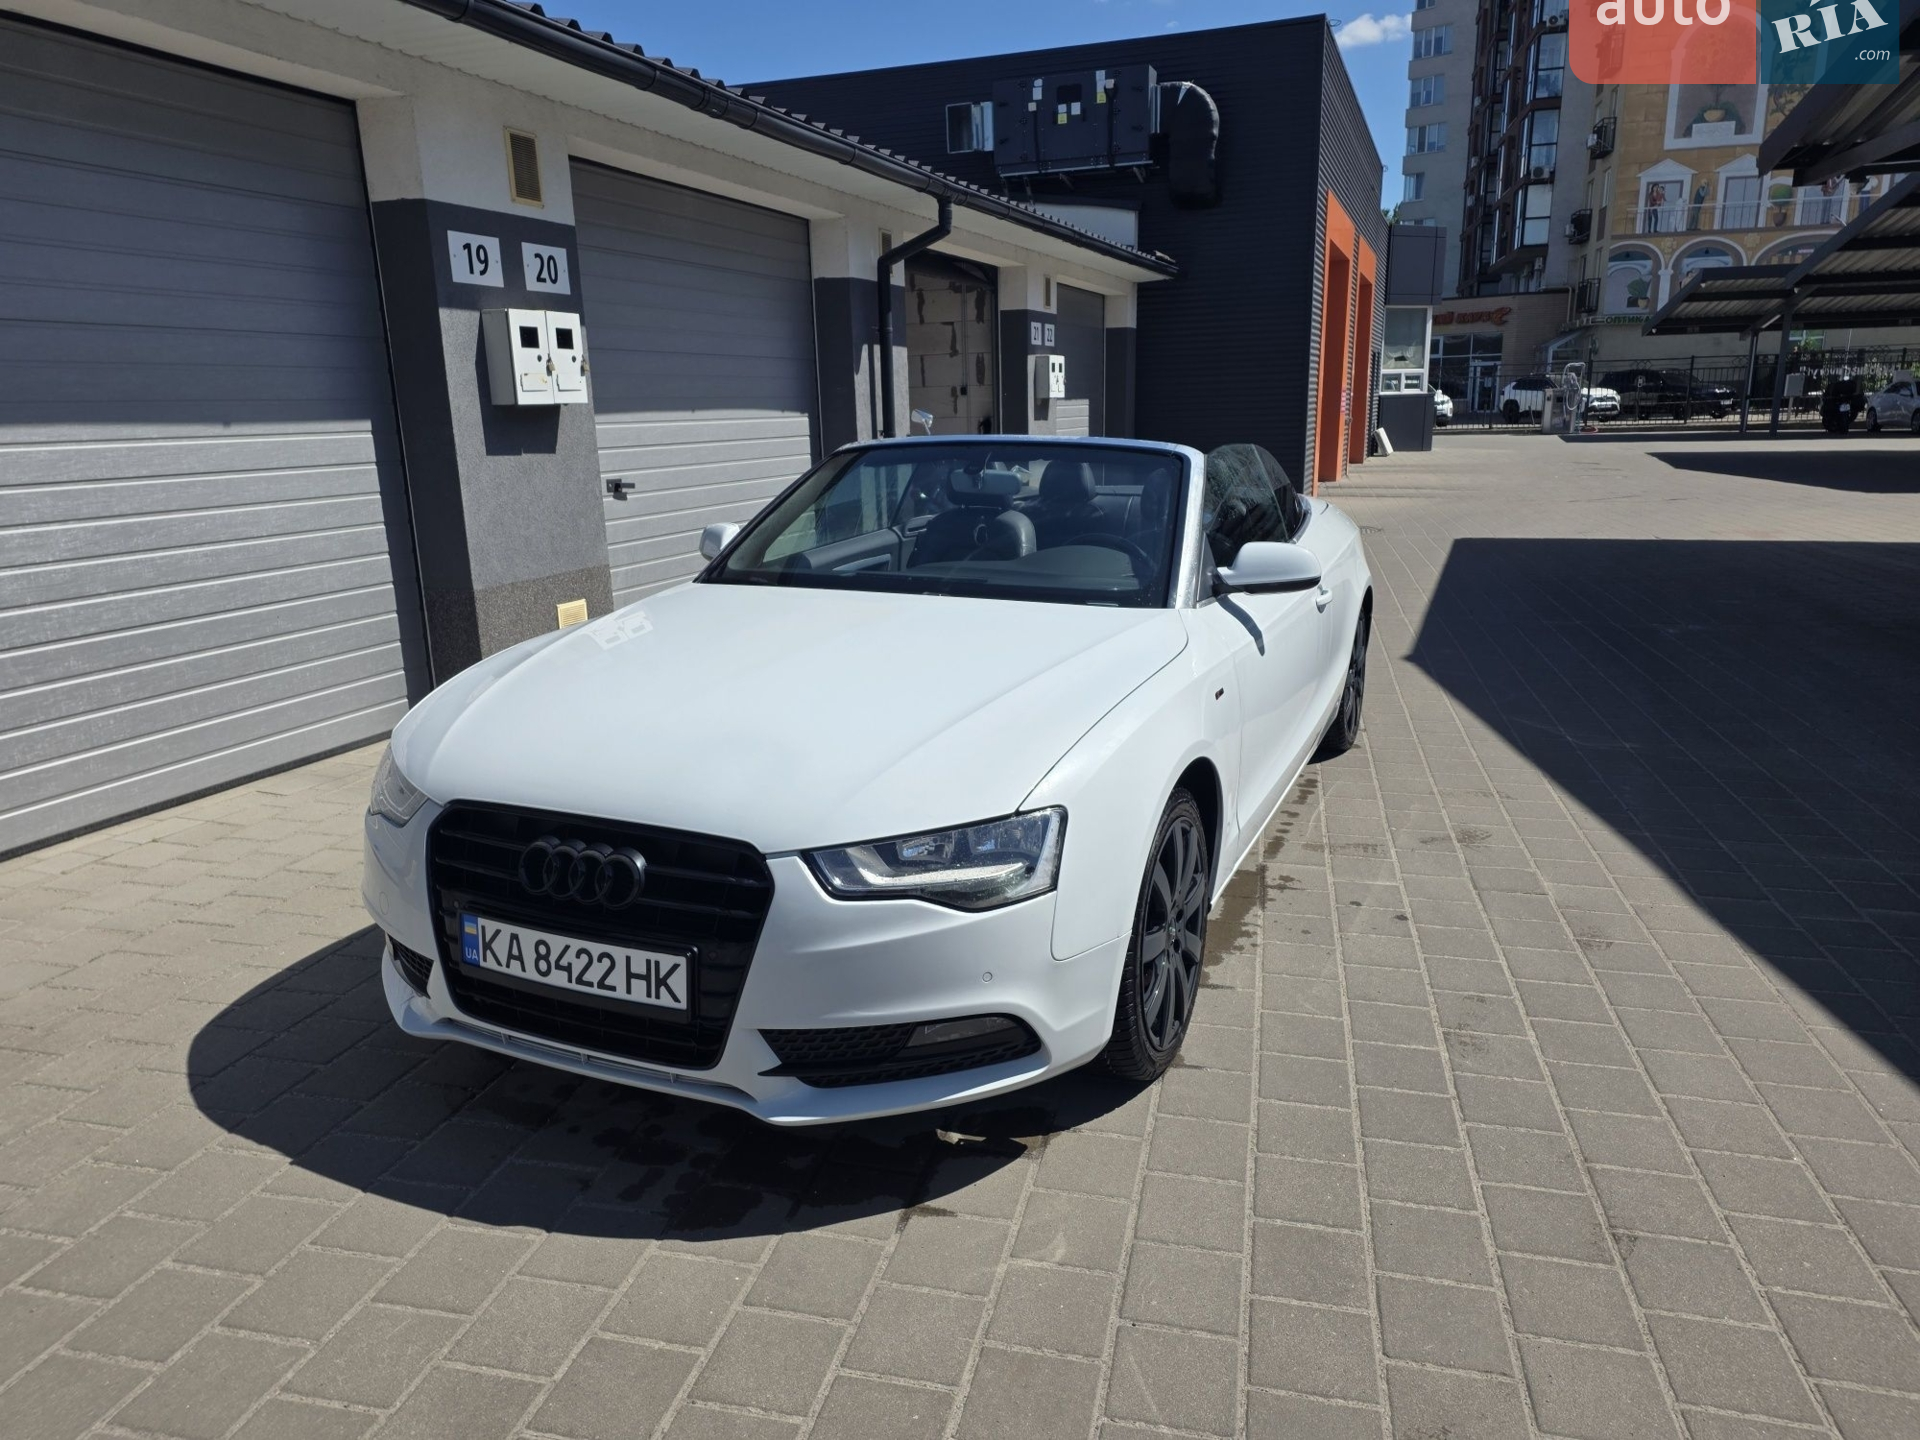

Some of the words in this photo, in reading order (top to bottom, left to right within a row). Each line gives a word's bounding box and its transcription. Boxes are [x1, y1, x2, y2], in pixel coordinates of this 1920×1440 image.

[462, 242, 489, 276] 19
[534, 252, 559, 285] 20
[465, 946, 479, 961] UA
[481, 925, 526, 972] KA
[534, 939, 617, 992] 8422
[625, 955, 682, 1003] HK
